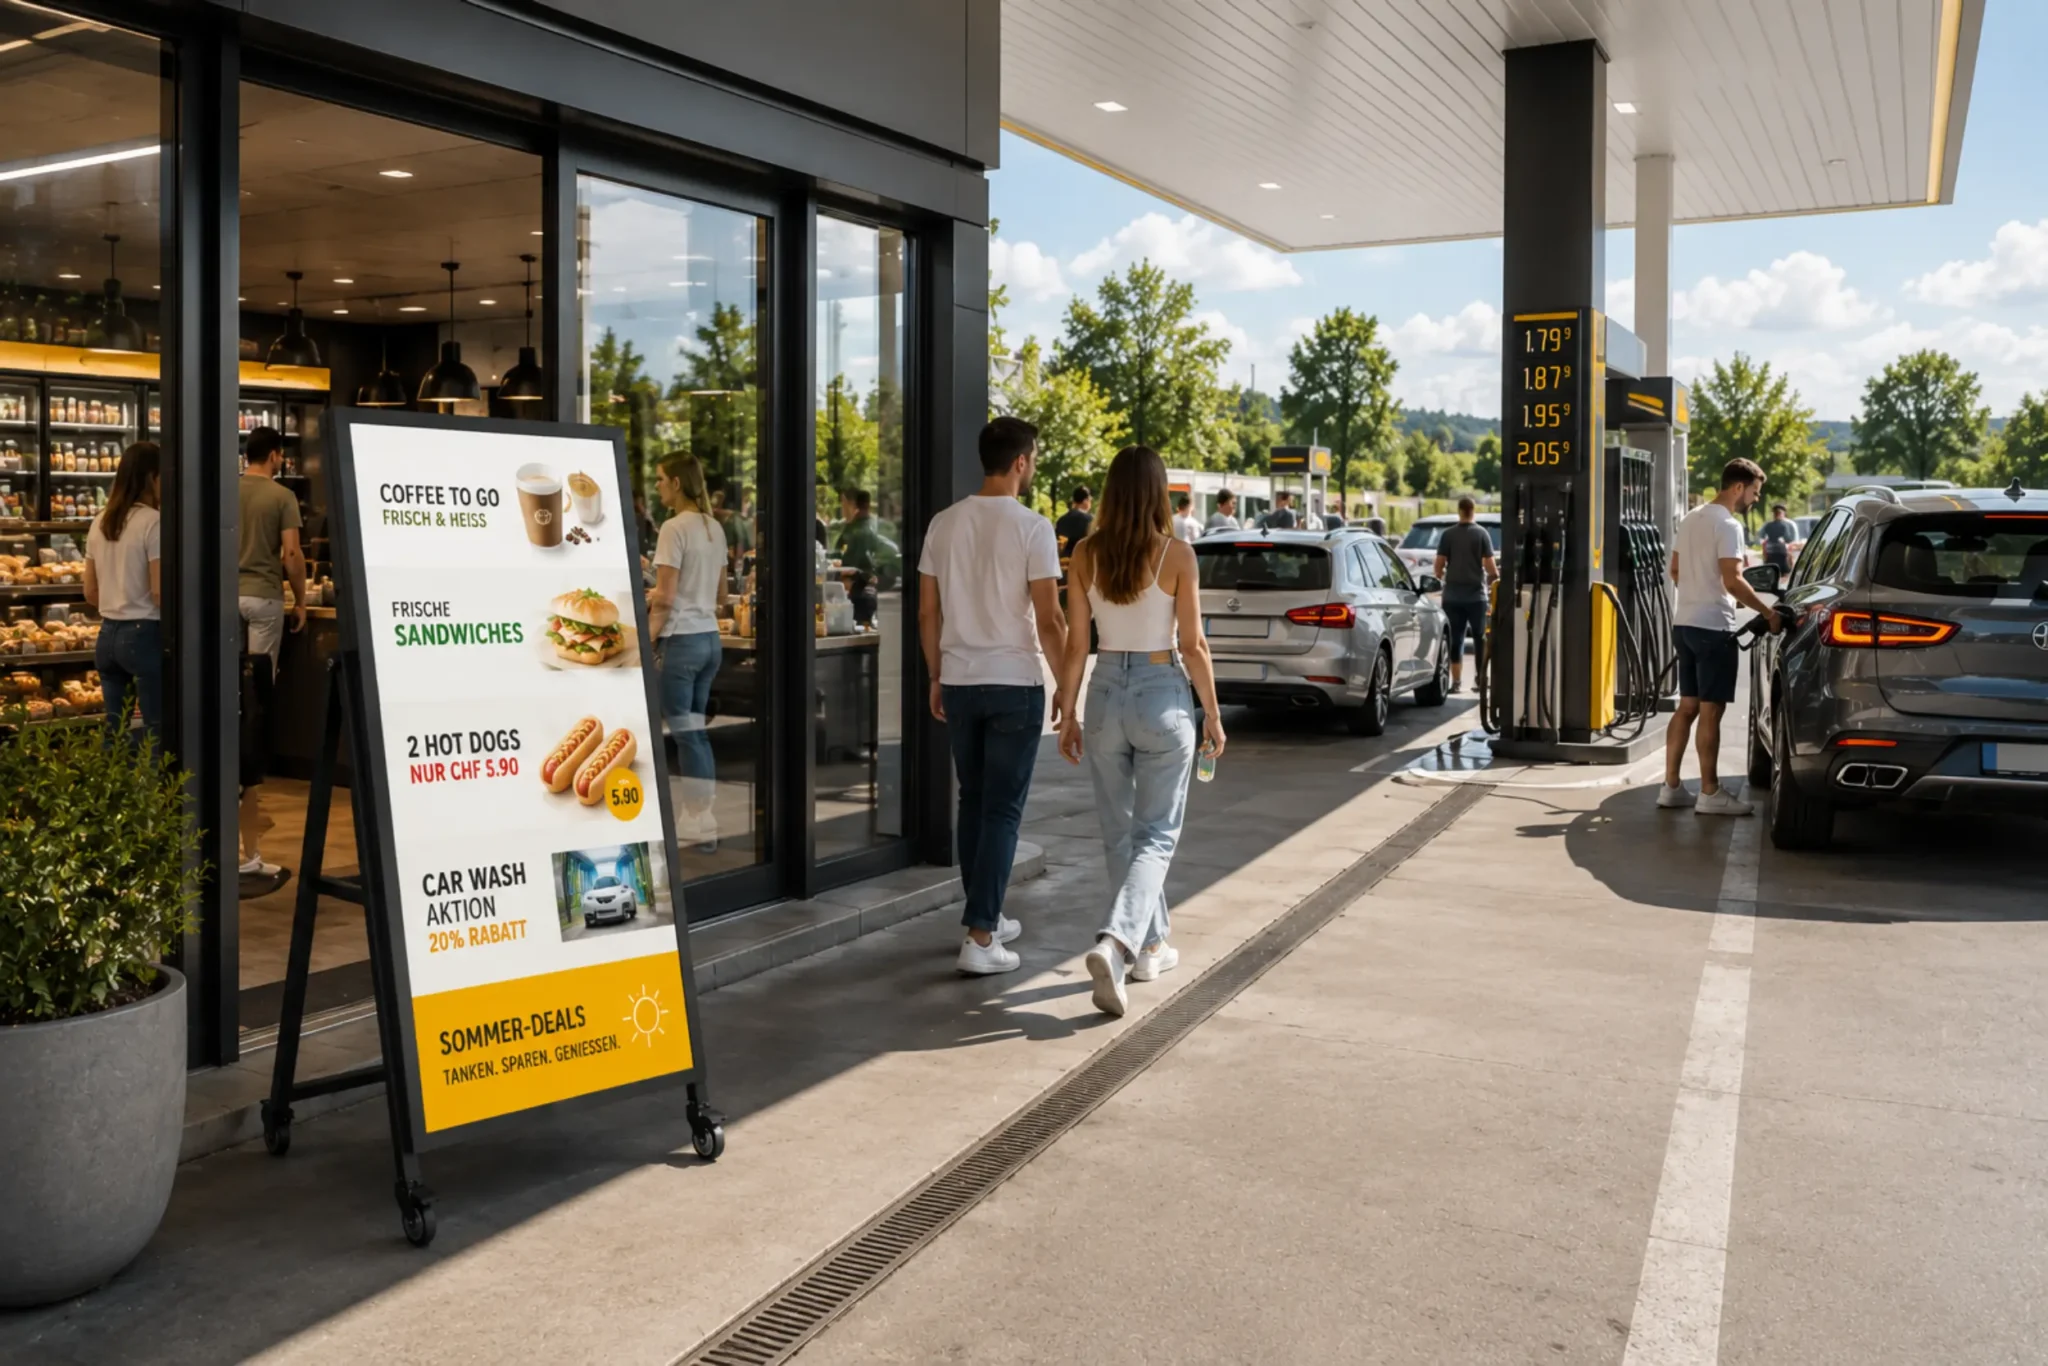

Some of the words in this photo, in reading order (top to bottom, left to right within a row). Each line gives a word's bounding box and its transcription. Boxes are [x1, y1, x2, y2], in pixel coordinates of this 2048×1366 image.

[380, 483, 445, 506] COFFEE
[449, 486, 472, 507] TO
[476, 487, 500, 508] GO
[382, 509, 432, 527] FRISCH
[436, 511, 446, 527] &
[449, 512, 487, 528] HEISS
[391, 601, 451, 618] FRISCHE
[394, 622, 524, 647] SANDWICHES
[407, 735, 420, 759] 2
[425, 732, 463, 757] HOT
[469, 729, 521, 754] DOGS
[410, 762, 446, 784] NUR
[450, 760, 481, 781] CHF
[485, 757, 519, 778] 5.90
[611, 787, 639, 806] 5.90
[422, 870, 464, 897] CAR
[468, 862, 527, 891] WASH
[426, 896, 496, 927] AKTION
[428, 928, 465, 953] 20%
[468, 919, 527, 947] RABATT
[439, 1005, 586, 1056] SOMMER-DEALS
[442, 1061, 499, 1086] TANKEN.
[501, 1049, 552, 1074] SPAREN.
[554, 1034, 621, 1062] GENIESSEN.
